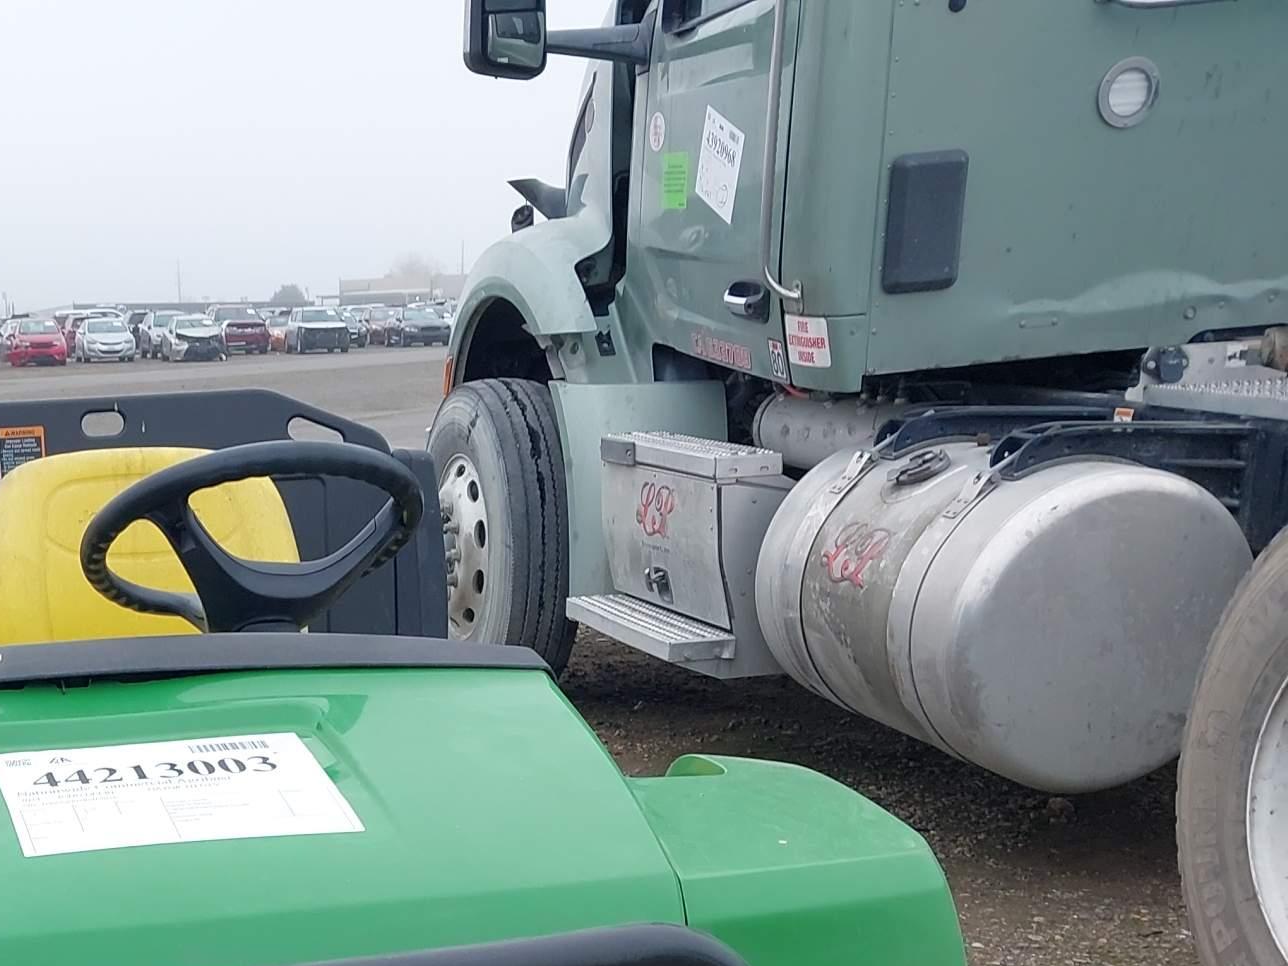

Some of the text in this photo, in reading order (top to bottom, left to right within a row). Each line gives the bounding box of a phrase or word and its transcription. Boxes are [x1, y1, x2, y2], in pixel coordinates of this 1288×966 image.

[797, 320, 809, 334] FIRE
[788, 334, 826, 350] EXTINGUISHER
[797, 351, 816, 364] INSIDE
[32, 755, 279, 788] 44213003
